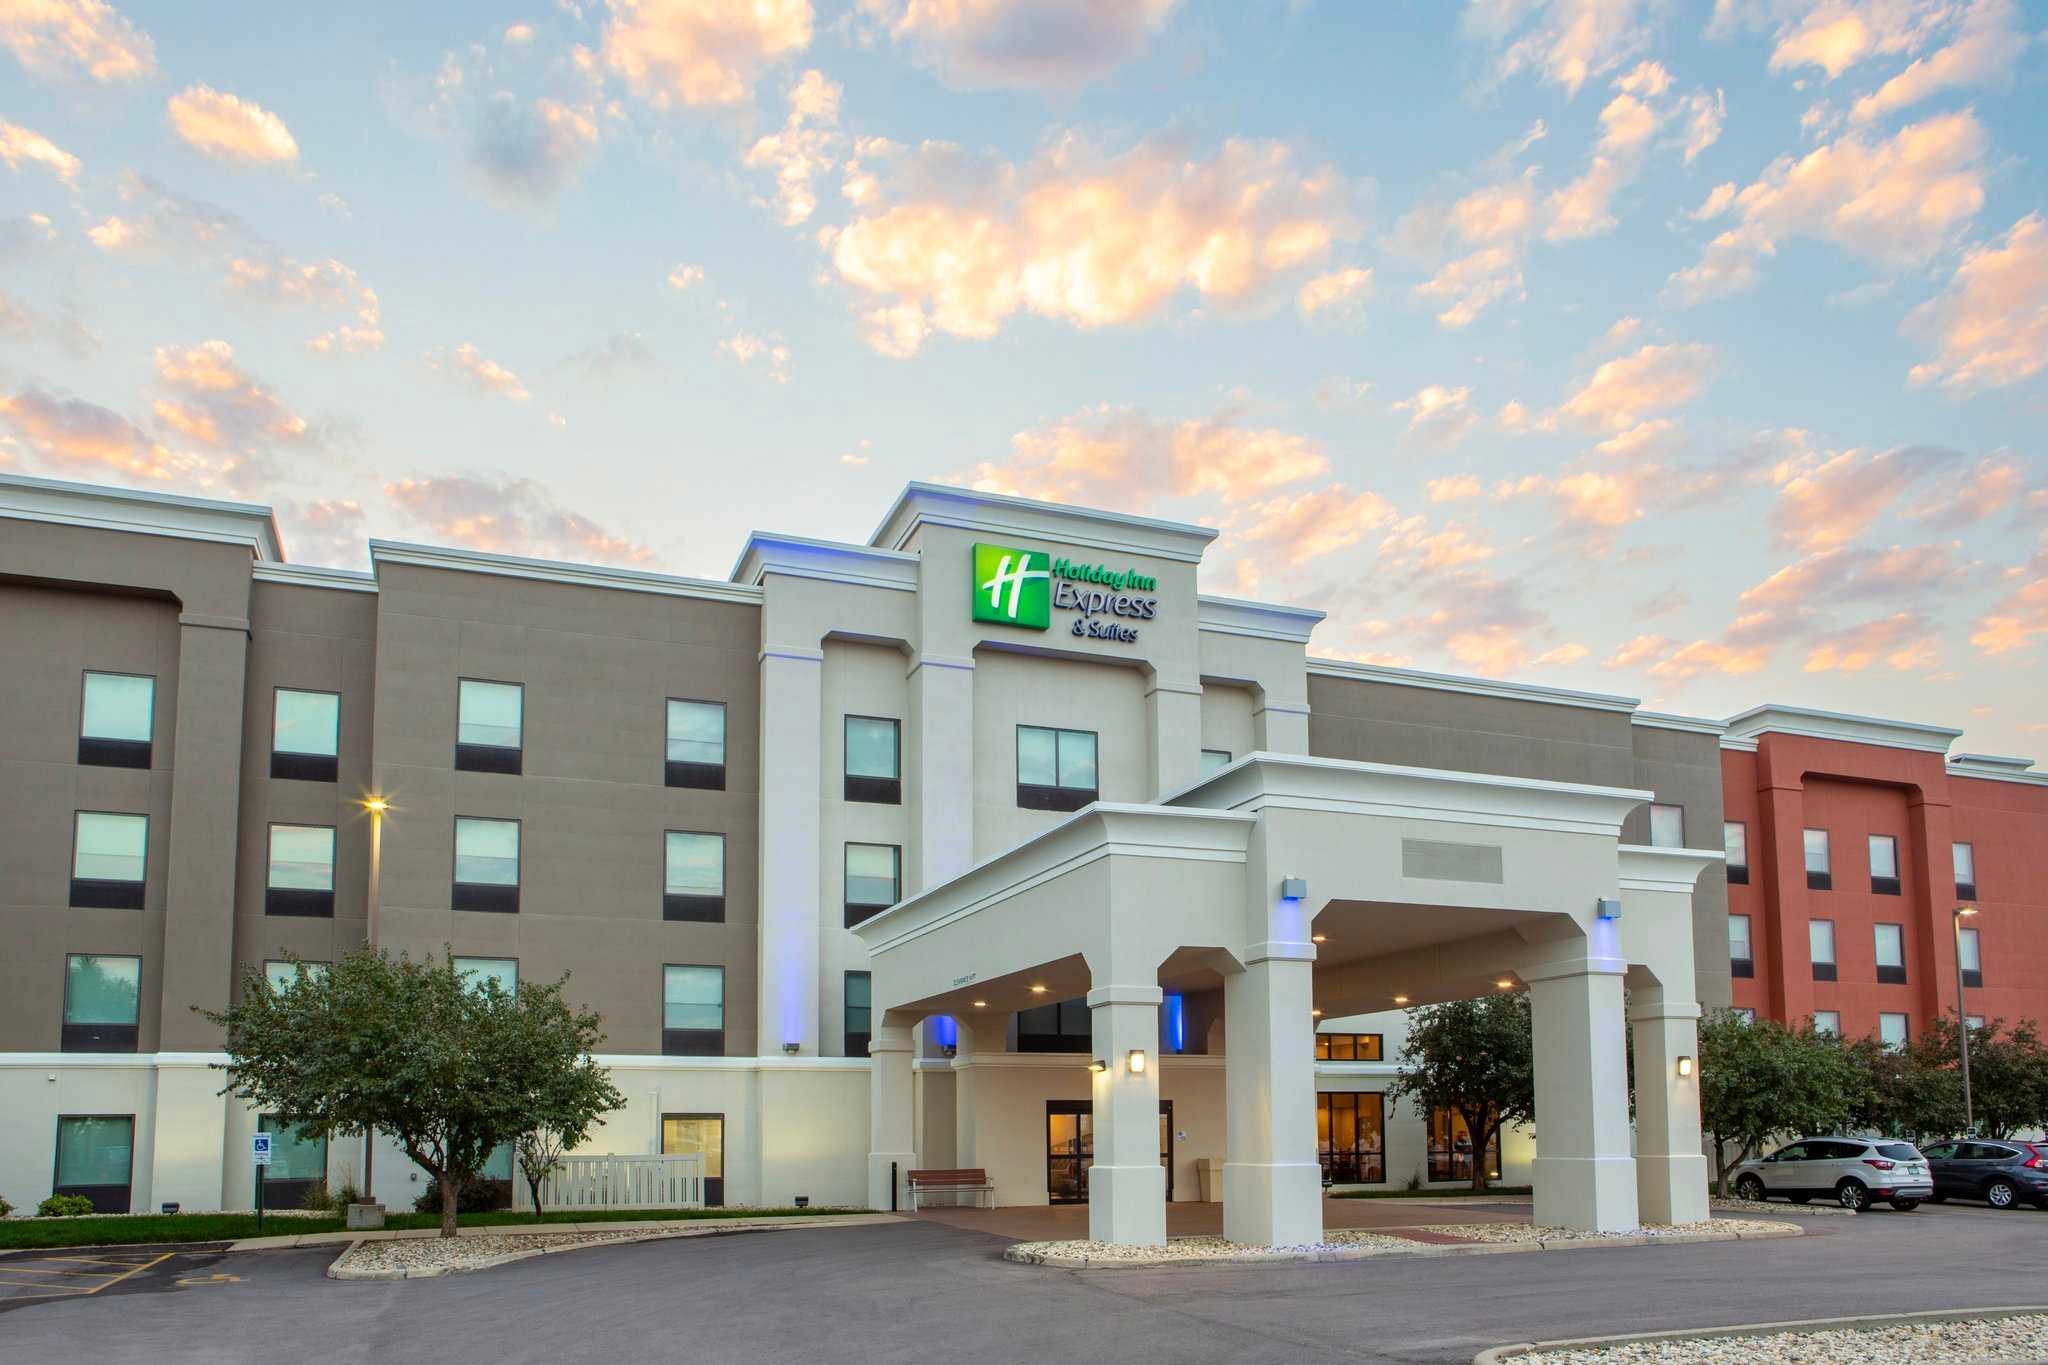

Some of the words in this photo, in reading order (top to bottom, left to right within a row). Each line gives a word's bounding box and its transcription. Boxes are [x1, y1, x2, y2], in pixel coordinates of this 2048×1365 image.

[1052, 558, 1125, 591] Holiday
[1126, 568, 1157, 592] Inn
[1053, 580, 1160, 620] Express
[1071, 619, 1085, 637] &
[1088, 620, 1138, 643] Suites
